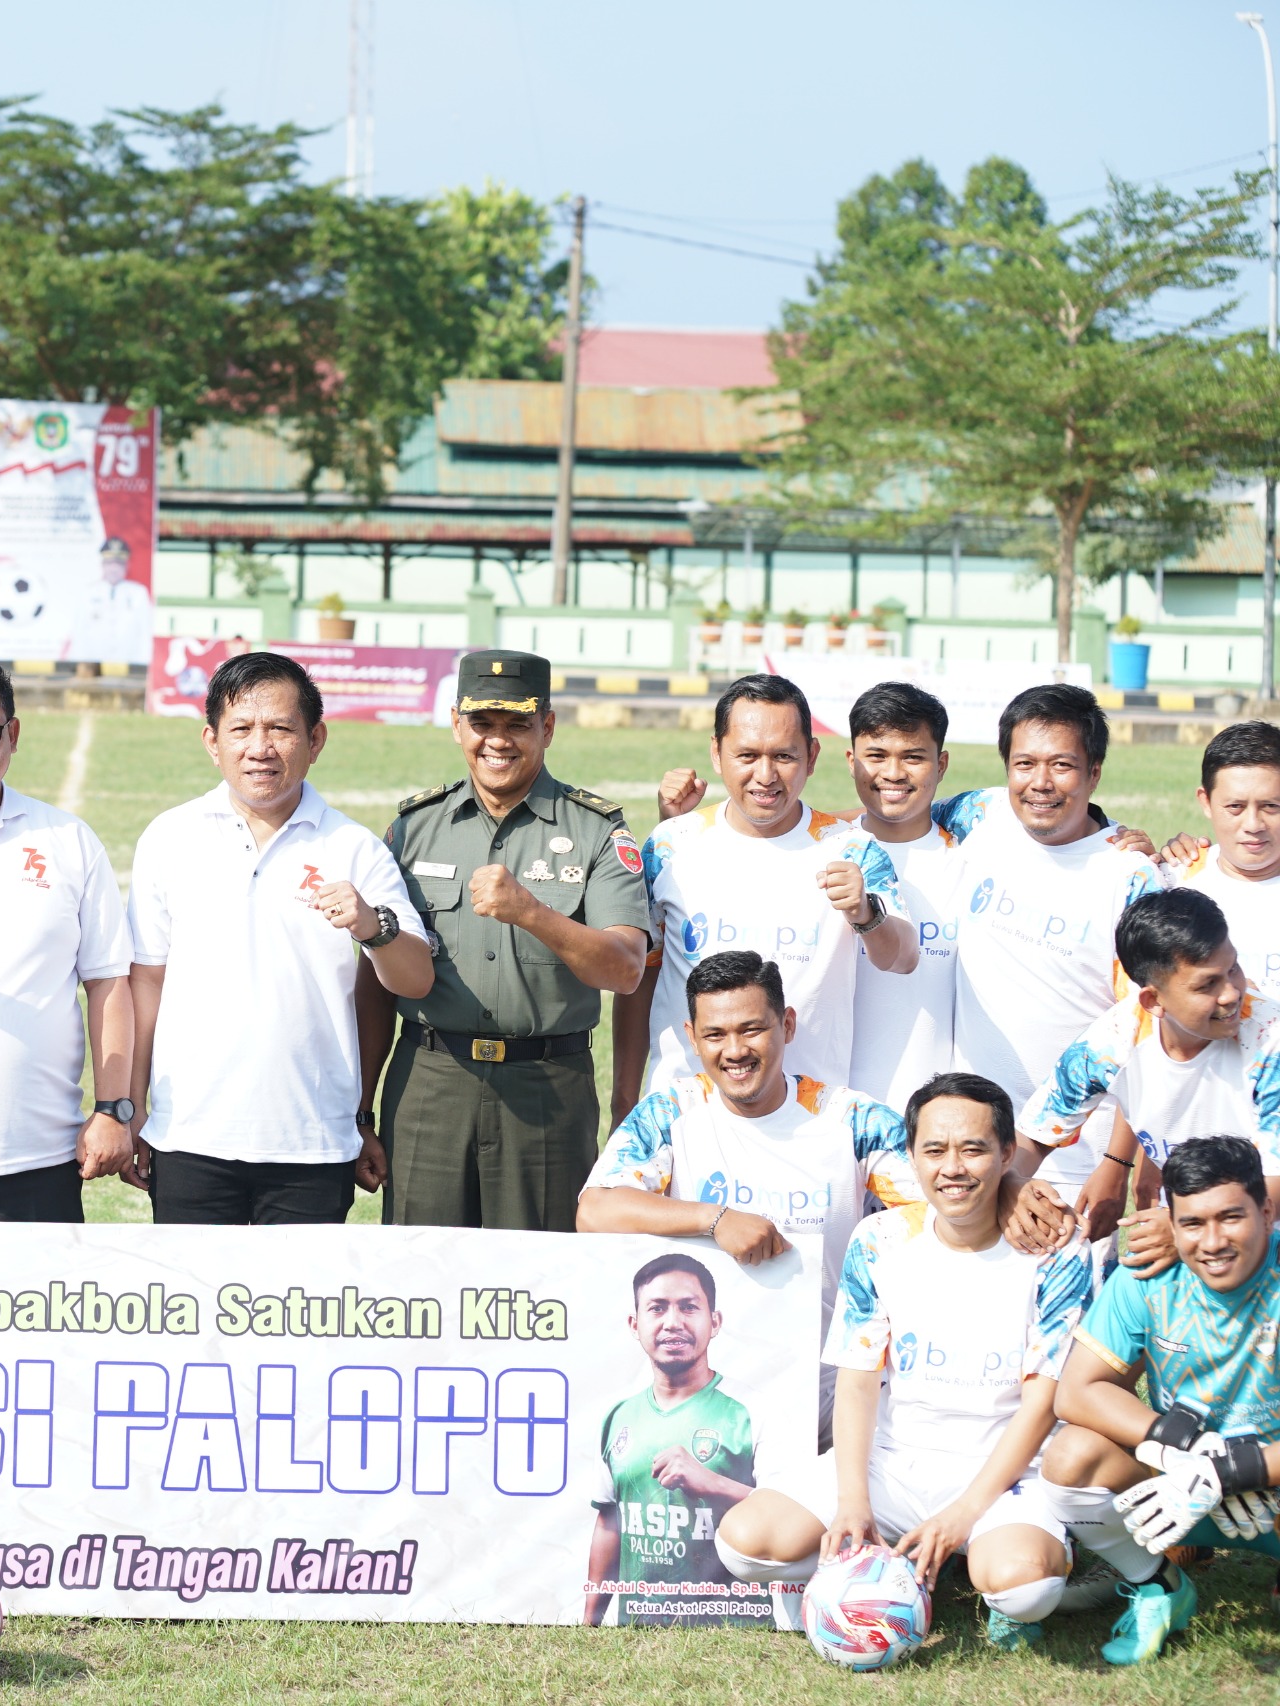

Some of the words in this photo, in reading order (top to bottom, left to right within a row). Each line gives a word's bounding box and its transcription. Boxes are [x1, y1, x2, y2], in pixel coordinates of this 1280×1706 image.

[98, 433, 139, 478] 79
[924, 947, 951, 958] Toraja
[1045, 941, 1073, 957] Toraja
[781, 952, 810, 963] Toraja
[795, 1216, 824, 1226] Toraja
[216, 1285, 442, 1339] Satukan
[460, 1288, 569, 1340] Kita
[989, 1378, 1019, 1388] Toraja
[92, 1360, 569, 1497] PALOPO
[630, 1536, 686, 1558] PALOPO
[60, 1534, 107, 1589] di
[111, 1535, 260, 1603] Tangan
[266, 1537, 418, 1595] Kalian!
[583, 1582, 599, 1593] dr.
[602, 1582, 636, 1593] Abdul
[637, 1582, 680, 1596] Syukur
[682, 1582, 730, 1597] Kuddus,
[733, 1583, 767, 1597] Sp.B.,
[627, 1602, 661, 1614] Ketua
[664, 1602, 698, 1614] Askot
[699, 1603, 730, 1615] PSSI
[731, 1603, 772, 1617] Palopo
